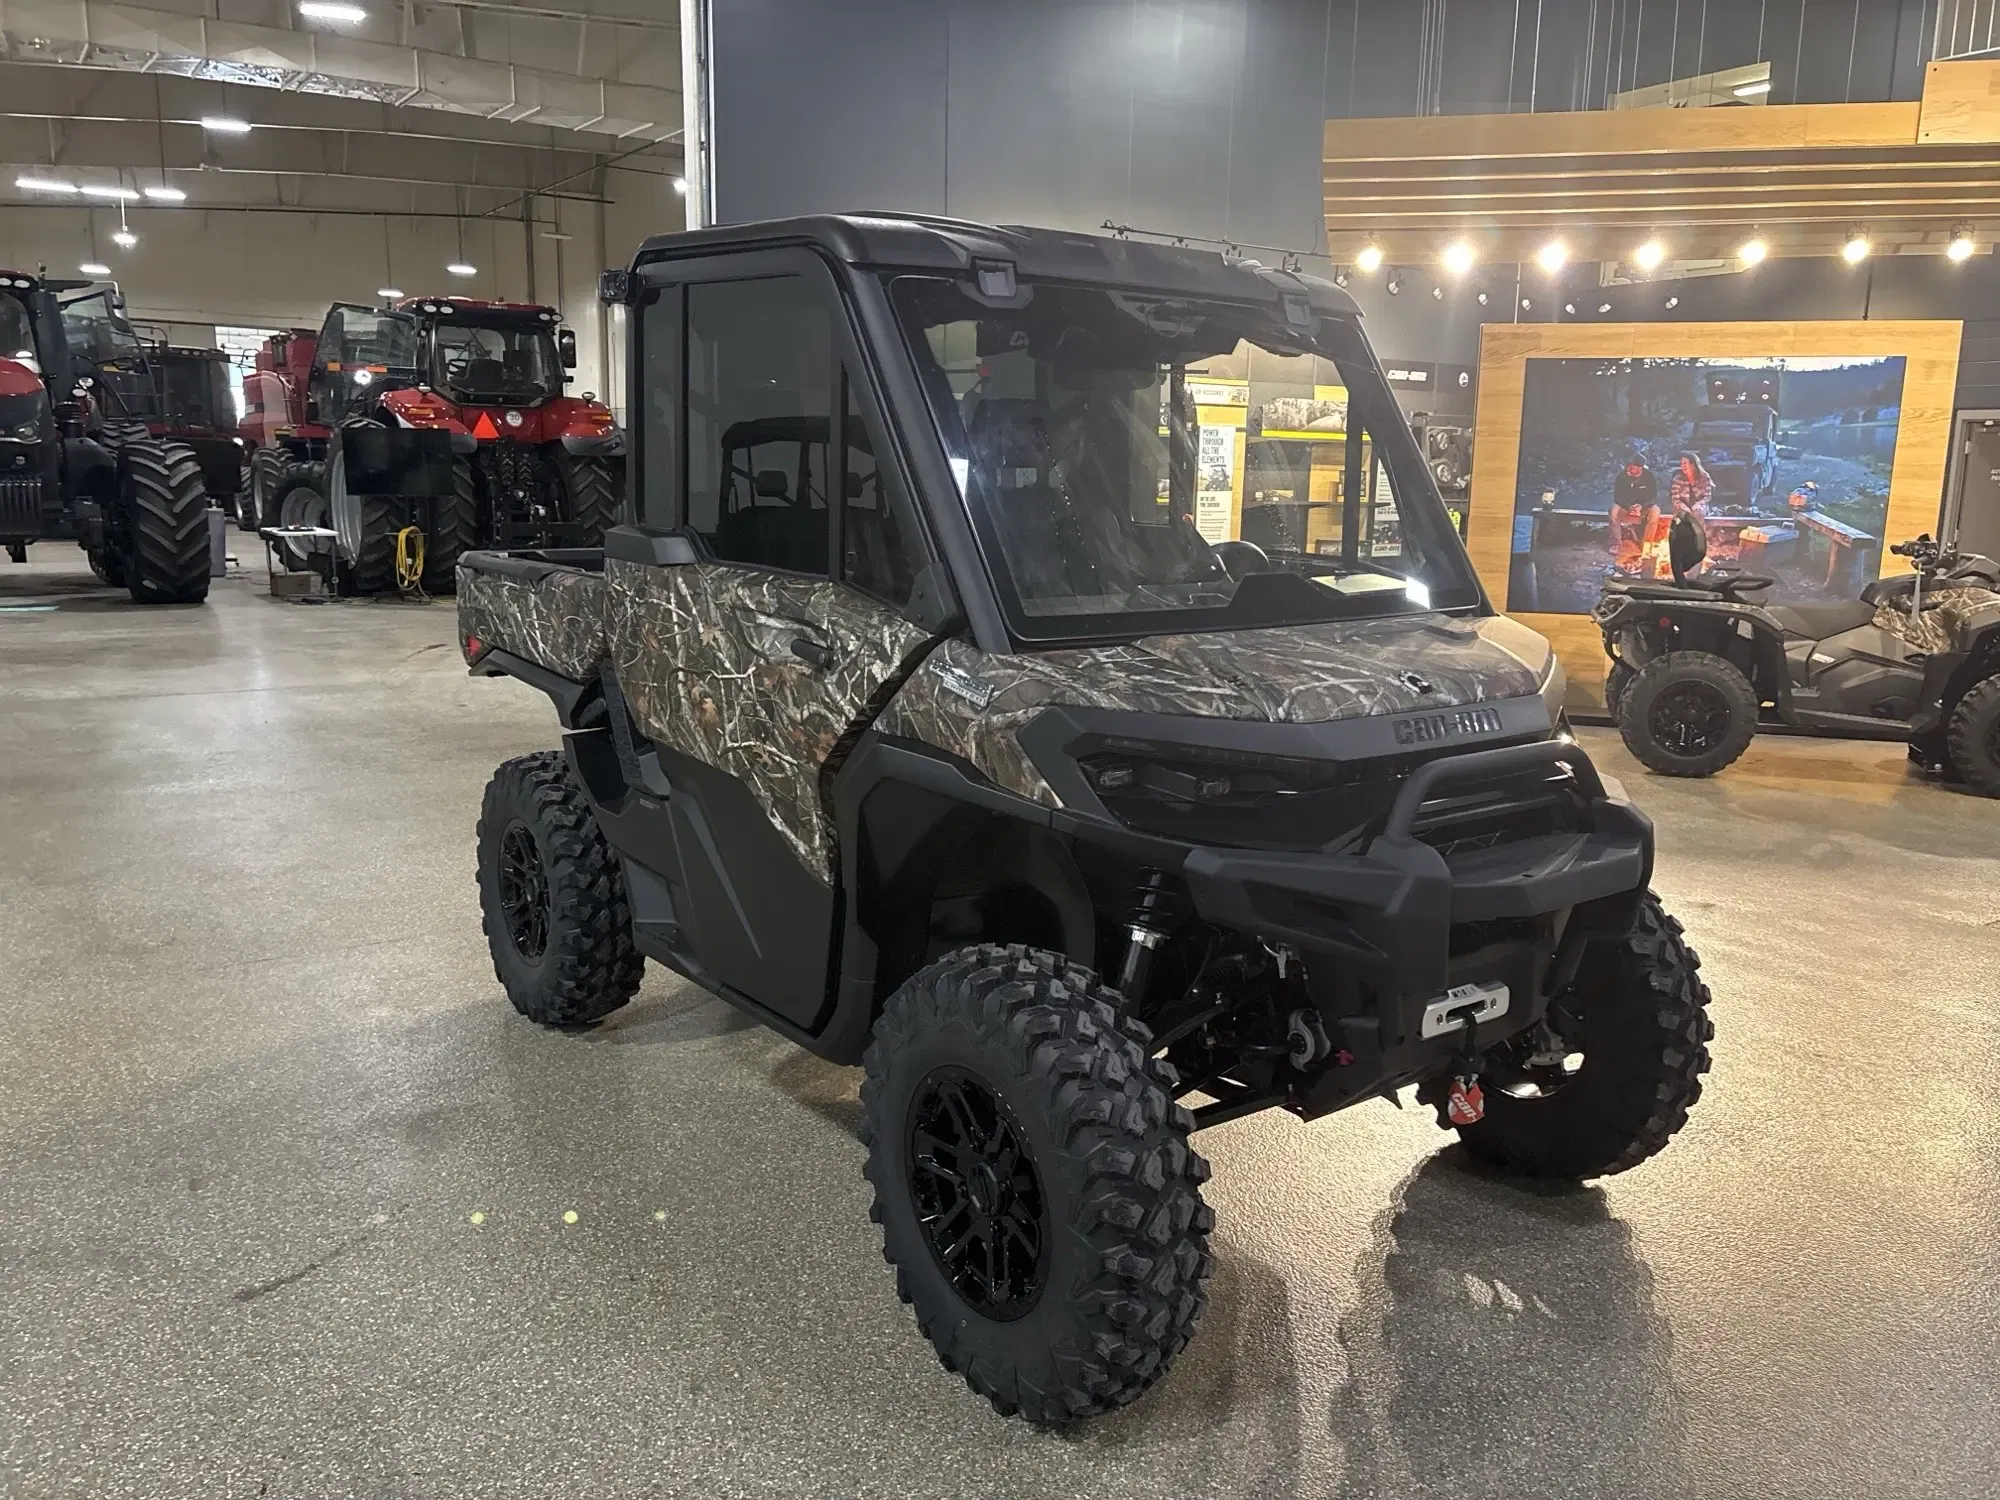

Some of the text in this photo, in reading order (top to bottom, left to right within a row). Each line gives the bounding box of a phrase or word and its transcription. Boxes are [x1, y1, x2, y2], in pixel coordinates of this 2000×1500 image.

[508, 413, 520, 421] 30
[1203, 428, 1219, 437] POWER
[1202, 437, 1224, 446] THROUGH
[1202, 446, 1220, 455] ALL THE
[1201, 456, 1225, 464] ELEMENTS
